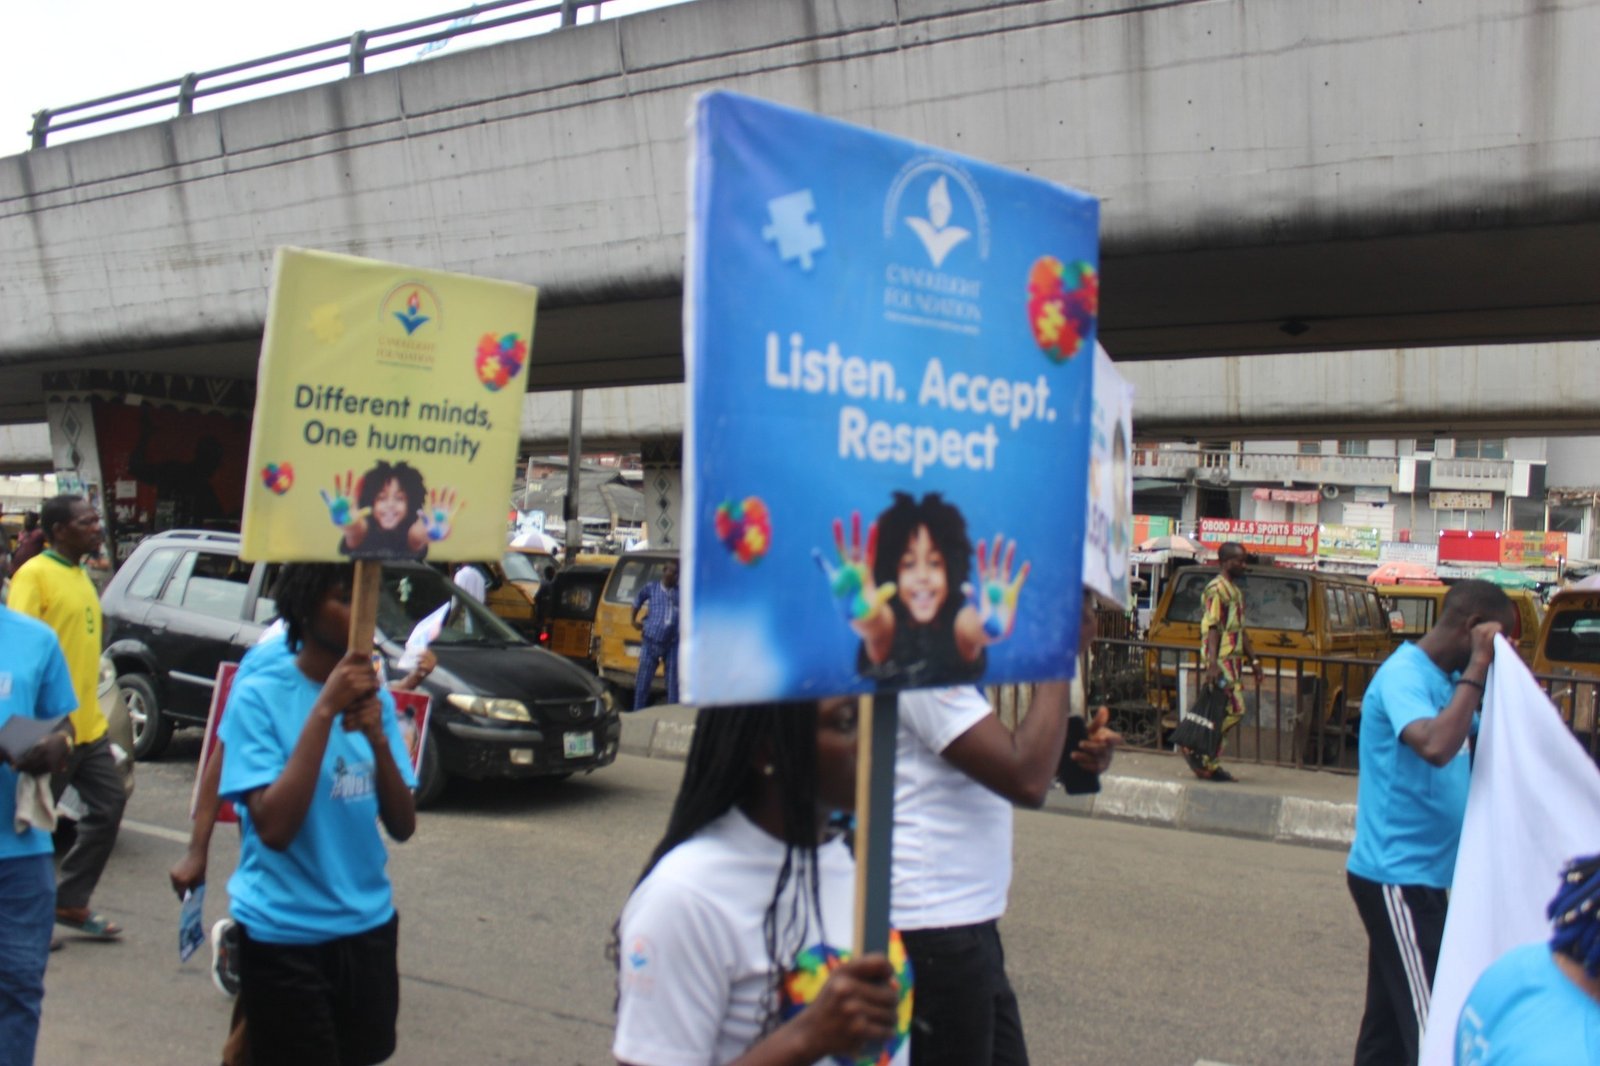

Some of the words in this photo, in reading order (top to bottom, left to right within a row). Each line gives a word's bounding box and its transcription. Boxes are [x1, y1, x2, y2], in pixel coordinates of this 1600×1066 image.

[765, 331, 906, 403] Listen.
[918, 356, 1056, 430] Accept.
[295, 384, 410, 418] Different
[418, 399, 492, 430] minds,
[303, 419, 357, 447] One
[367, 423, 480, 463] humanity
[839, 405, 998, 479] Respect
[1202, 521, 1230, 532] OBODO
[1257, 523, 1289, 535] SPORTS
[1292, 525, 1315, 537] SHOP
